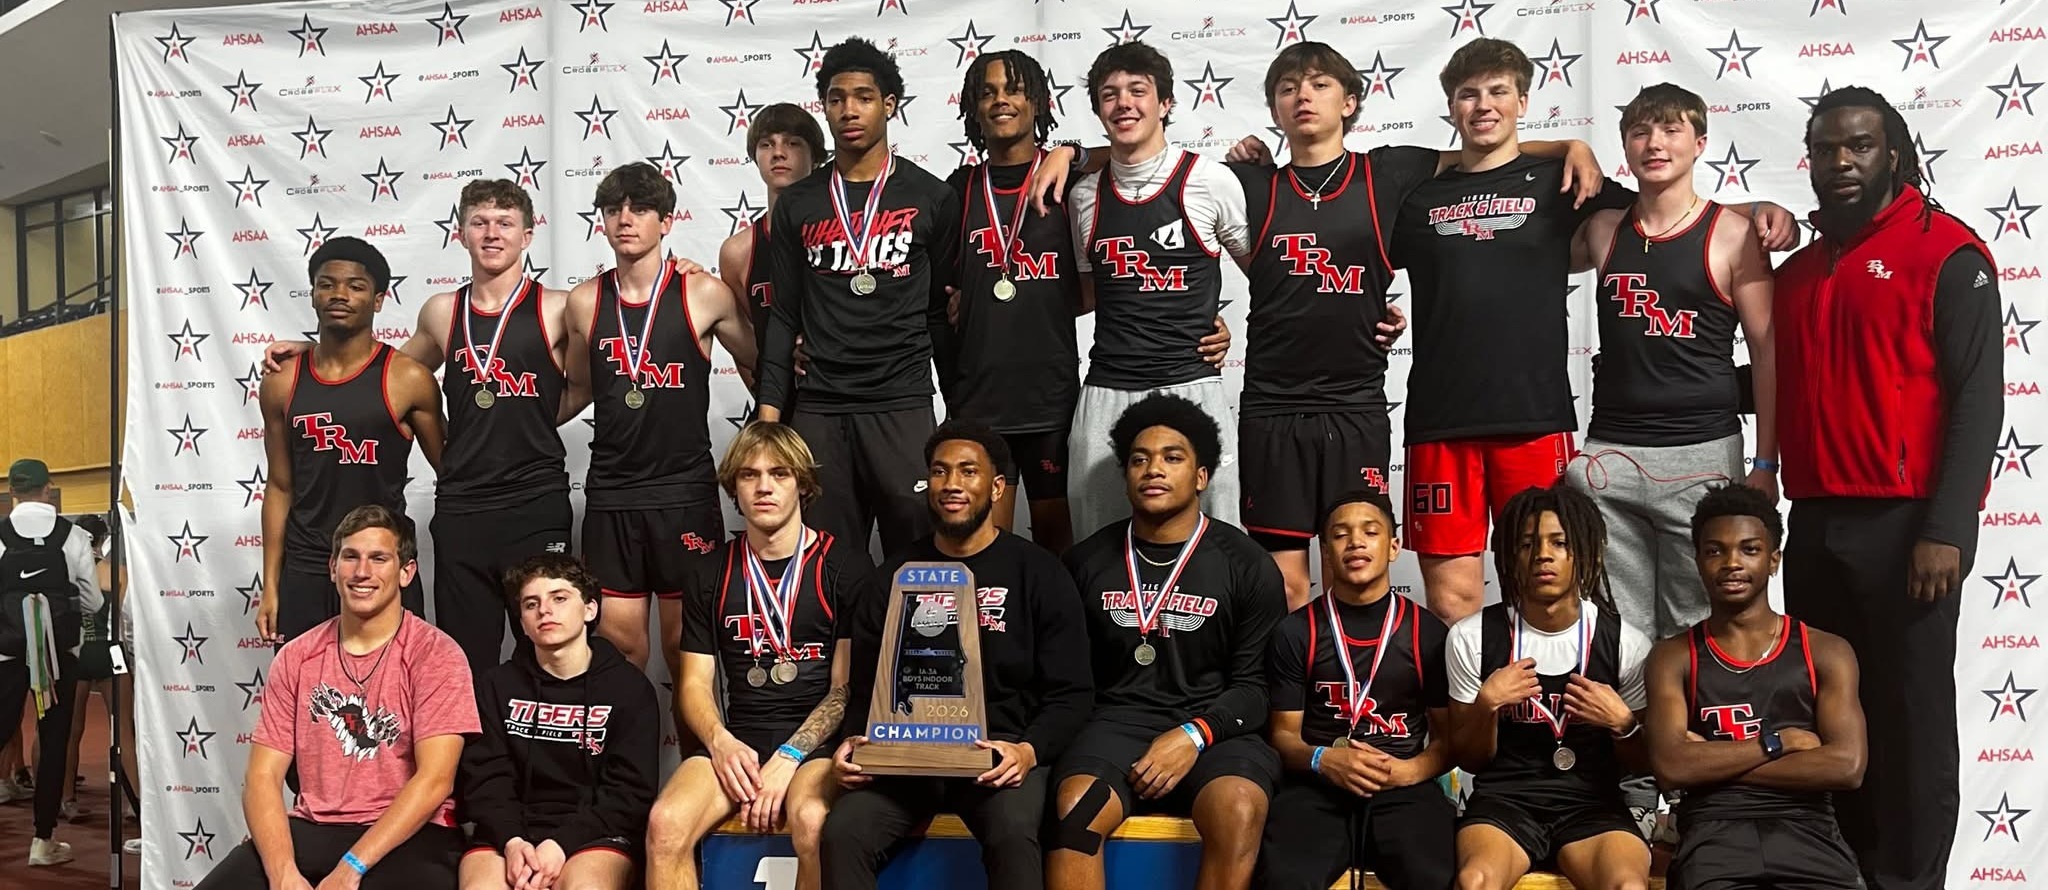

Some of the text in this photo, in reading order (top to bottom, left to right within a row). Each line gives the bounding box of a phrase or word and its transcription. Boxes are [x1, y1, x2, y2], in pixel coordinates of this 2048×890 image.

[644, 0, 688, 13] AHSAA
[500, 7, 542, 22] AHSAA
[356, 23, 398, 36] AHSAA
[1989, 27, 2046, 42] AHSAA
[223, 34, 264, 46] AHSAA
[1799, 43, 1855, 57] AHSAA
[1617, 50, 1671, 65] AHSAA
[646, 108, 690, 120] AHSAA
[1707, 102, 1770, 114] HSAA_SPORTS
[503, 114, 545, 128] AHSAA
[360, 125, 401, 138] AHSAA
[227, 135, 265, 147] AHSAA
[1985, 141, 2042, 160] AHSAA
[708, 157, 753, 166] @AHSAA_S
[1428, 201, 1475, 225] TRACK
[1475, 200, 1490, 216] &
[1489, 198, 1536, 215] FIELD
[233, 230, 269, 242] AHSAA
[365, 224, 405, 236] AHSAA
[1095, 236, 1188, 292] TRM
[1272, 233, 1365, 294] TRM
[426, 276, 473, 285] @AHSAA_SP
[1998, 266, 2041, 281] HSAA
[1604, 273, 1698, 338] TRM
[232, 333, 276, 344] AHSAA
[2003, 382, 2041, 396] SAA
[237, 428, 264, 440] AHSA
[293, 412, 378, 464] TRM
[1983, 512, 2041, 526] AHSAA
[235, 536, 262, 547] AHS
[908, 570, 960, 582] STATE
[1102, 591, 1218, 616] TRAK FIELD
[237, 638, 274, 648] AHS
[1982, 635, 2040, 649] AHSAA
[508, 698, 612, 728] TIGERS
[926, 705, 968, 718] 2026
[1700, 704, 1762, 742] TR
[874, 726, 978, 740] CHAMPION
[1978, 749, 2033, 762] AHSAA
[1970, 868, 2026, 882] AHSAA
